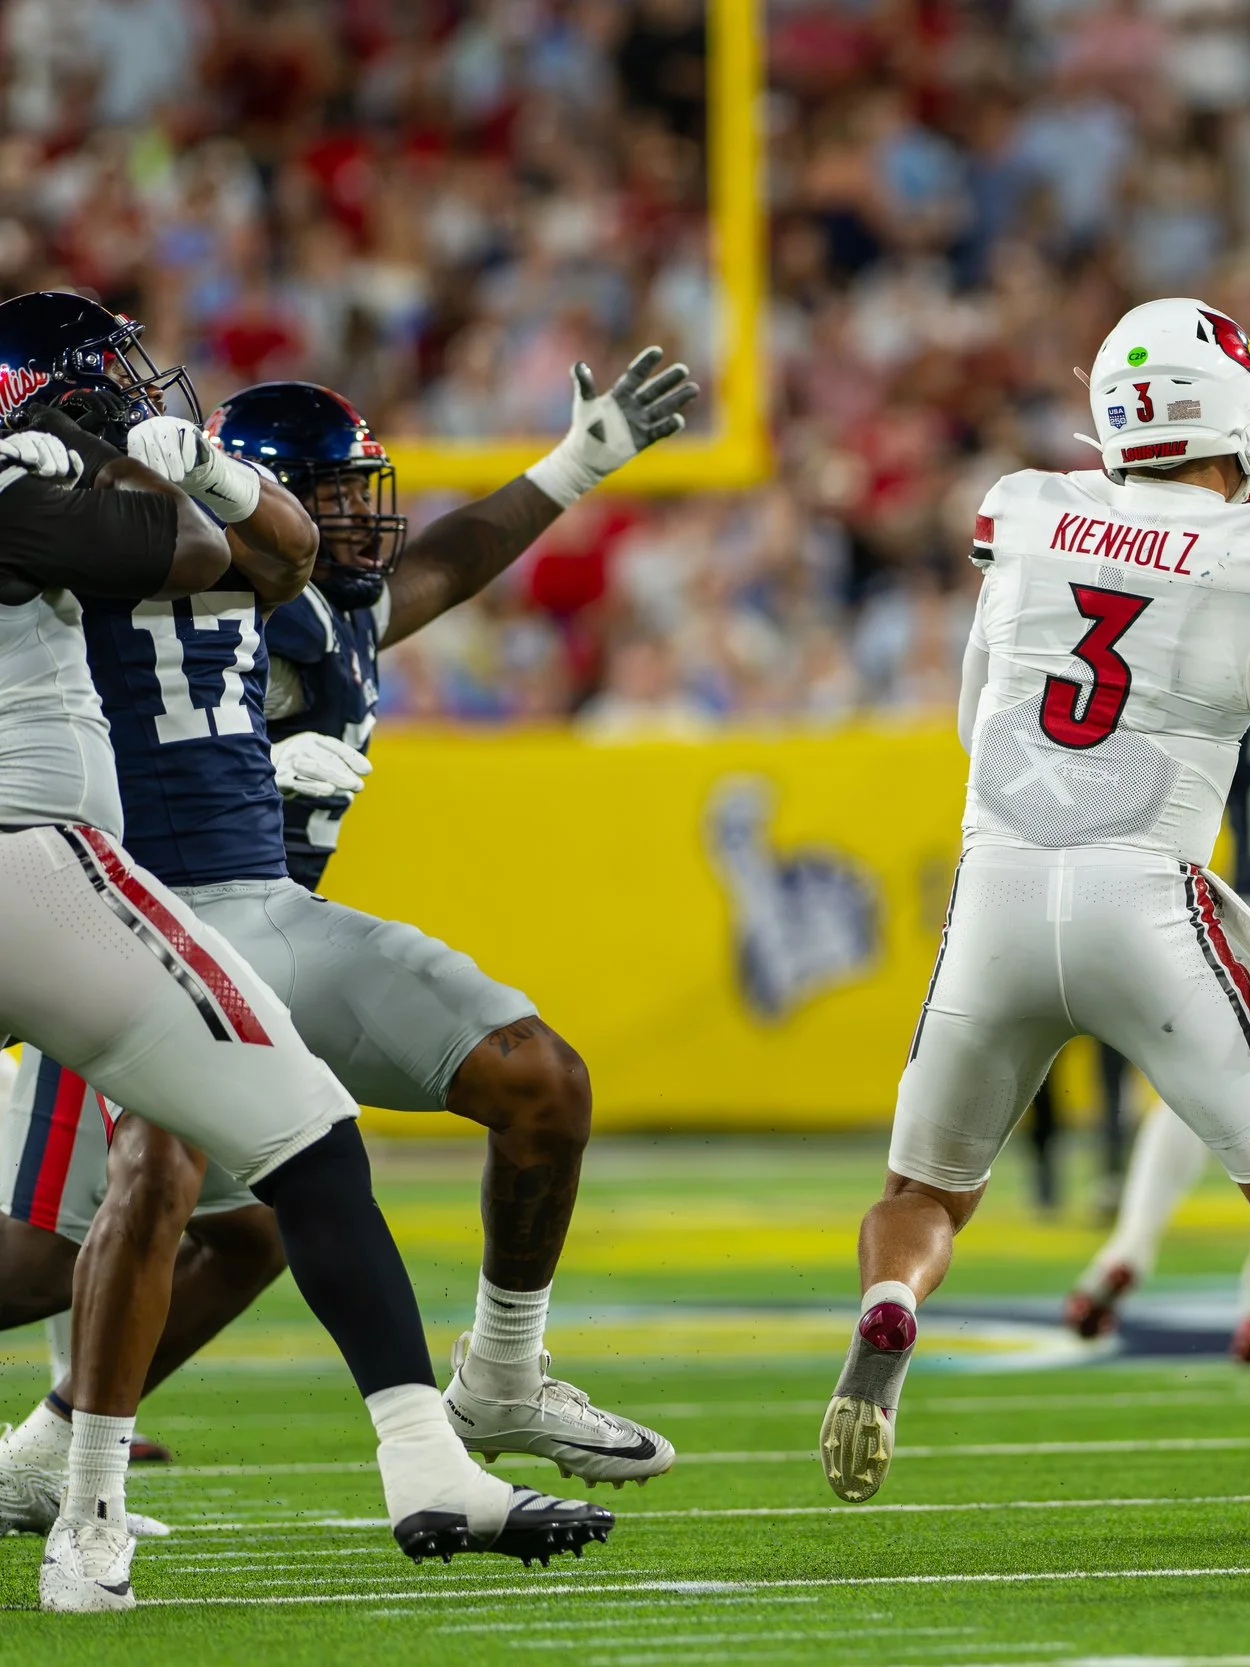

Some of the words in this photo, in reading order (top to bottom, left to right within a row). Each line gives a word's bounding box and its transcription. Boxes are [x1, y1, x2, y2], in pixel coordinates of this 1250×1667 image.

[1128, 351, 1146, 361] C2P
[1108, 407, 1124, 415] USA
[1132, 381, 1154, 422] 3
[1121, 440, 1188, 463] LOUISVILLE
[1050, 512, 1199, 575] KIENHOLZ
[132, 591, 261, 744] 17
[1040, 582, 1154, 750] 3
